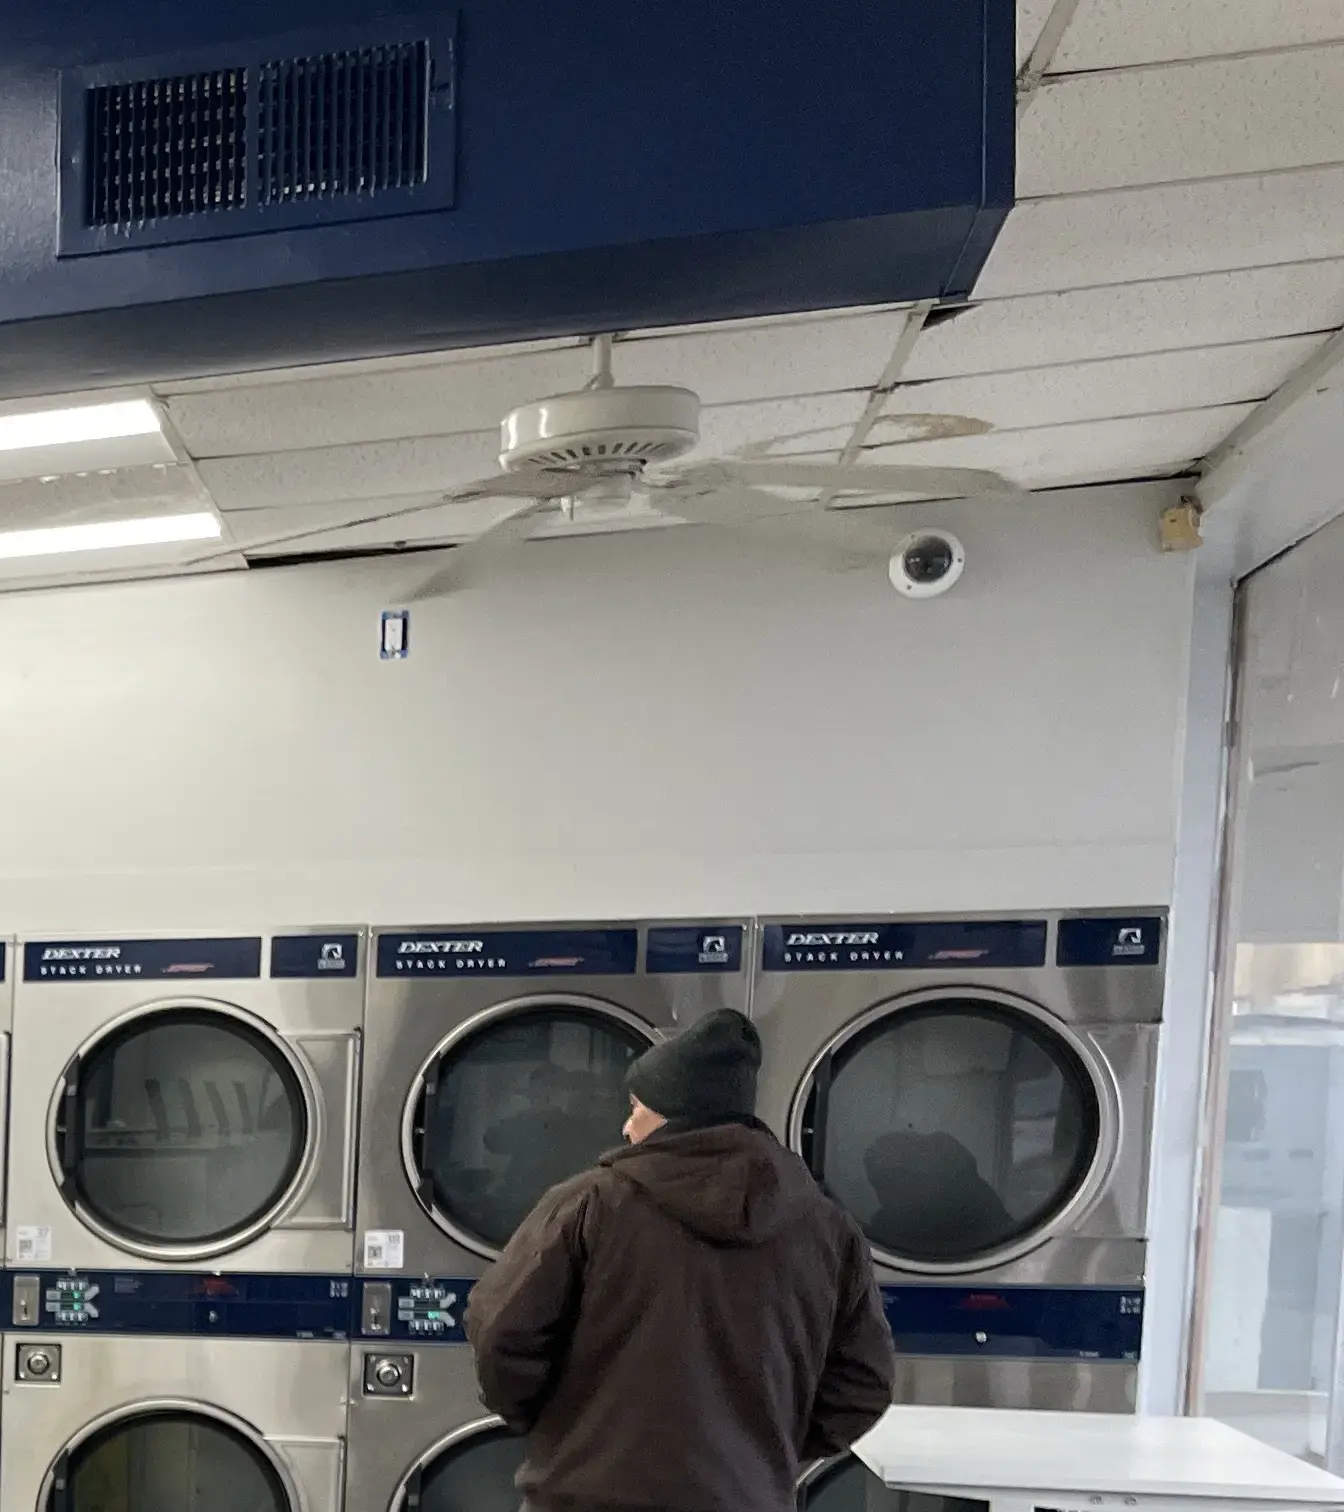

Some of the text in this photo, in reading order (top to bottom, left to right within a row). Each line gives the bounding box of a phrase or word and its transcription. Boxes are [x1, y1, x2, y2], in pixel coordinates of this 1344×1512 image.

[786, 931, 879, 946] DEXTER
[42, 946, 122, 961] DEXTER
[397, 940, 483, 954] DEXTER
